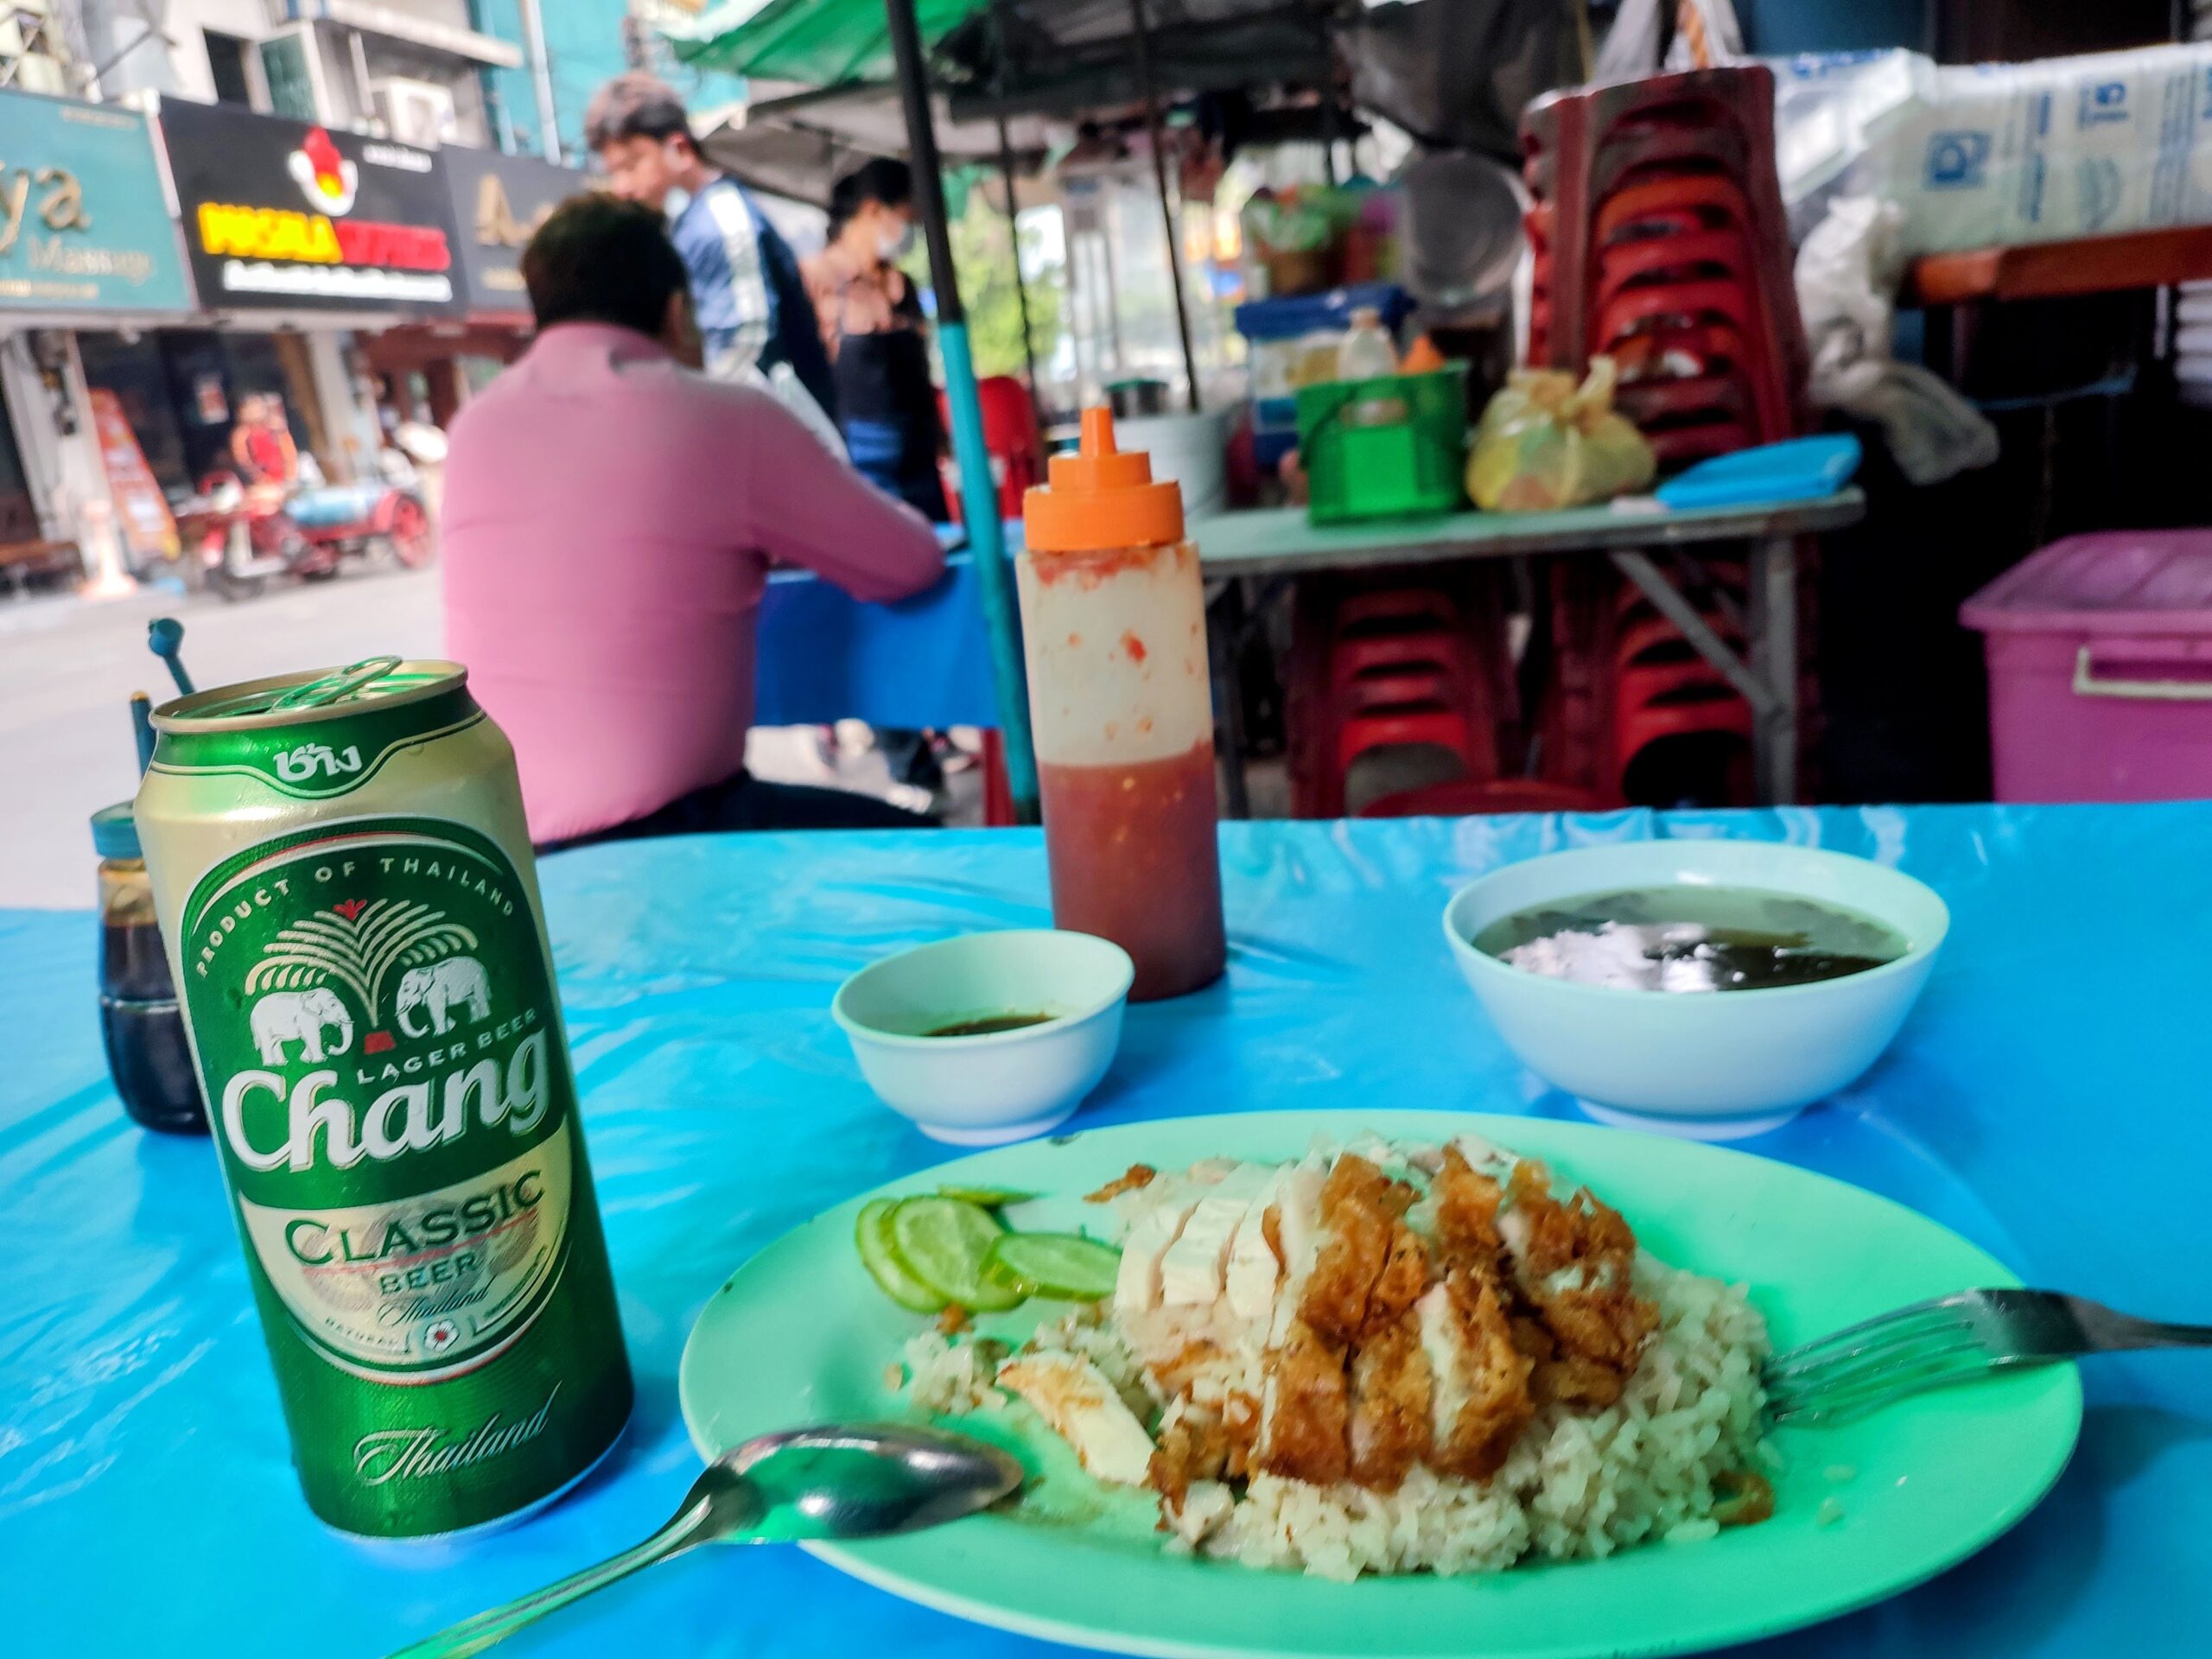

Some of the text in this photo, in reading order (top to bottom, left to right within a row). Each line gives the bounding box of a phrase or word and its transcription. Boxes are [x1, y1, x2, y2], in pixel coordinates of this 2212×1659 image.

[273, 743, 362, 782] ช้าง
[196, 857, 513, 978] PRODUCT OF THAILAND
[357, 1007, 537, 1084] LAGER BEER
[222, 1027, 550, 1173] Chang
[285, 1170, 546, 1265] CLASSIC
[380, 1251, 477, 1294] BEER
[353, 1380, 563, 1486] Thailand
